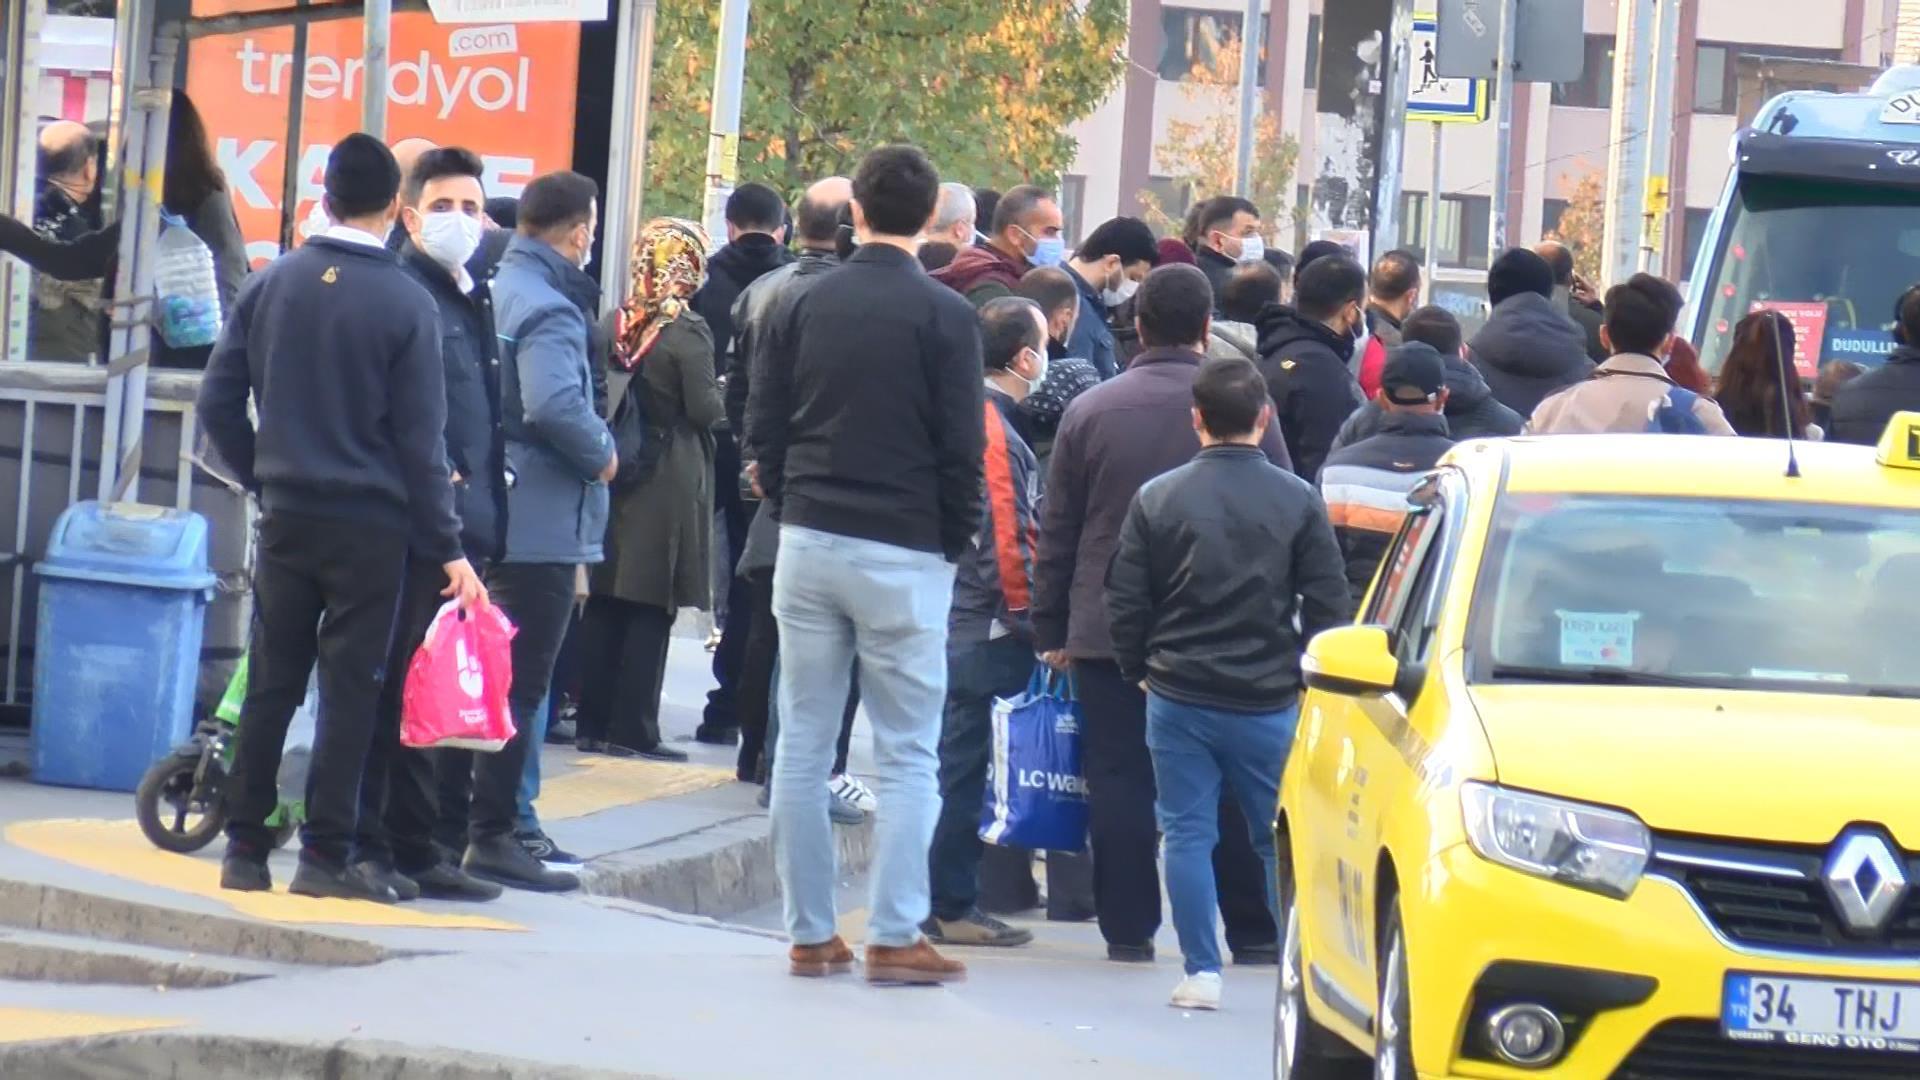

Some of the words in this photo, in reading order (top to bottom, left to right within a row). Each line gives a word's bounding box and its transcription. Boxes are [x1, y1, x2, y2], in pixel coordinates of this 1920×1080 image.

[453, 31, 511, 51] .com
[1019, 767, 1045, 788] LC
[1731, 1003, 1748, 1018] TR
[1752, 982, 1797, 1026] 34
[1833, 987, 1902, 1032] THJ
[1844, 1036, 1887, 1050] OTO
